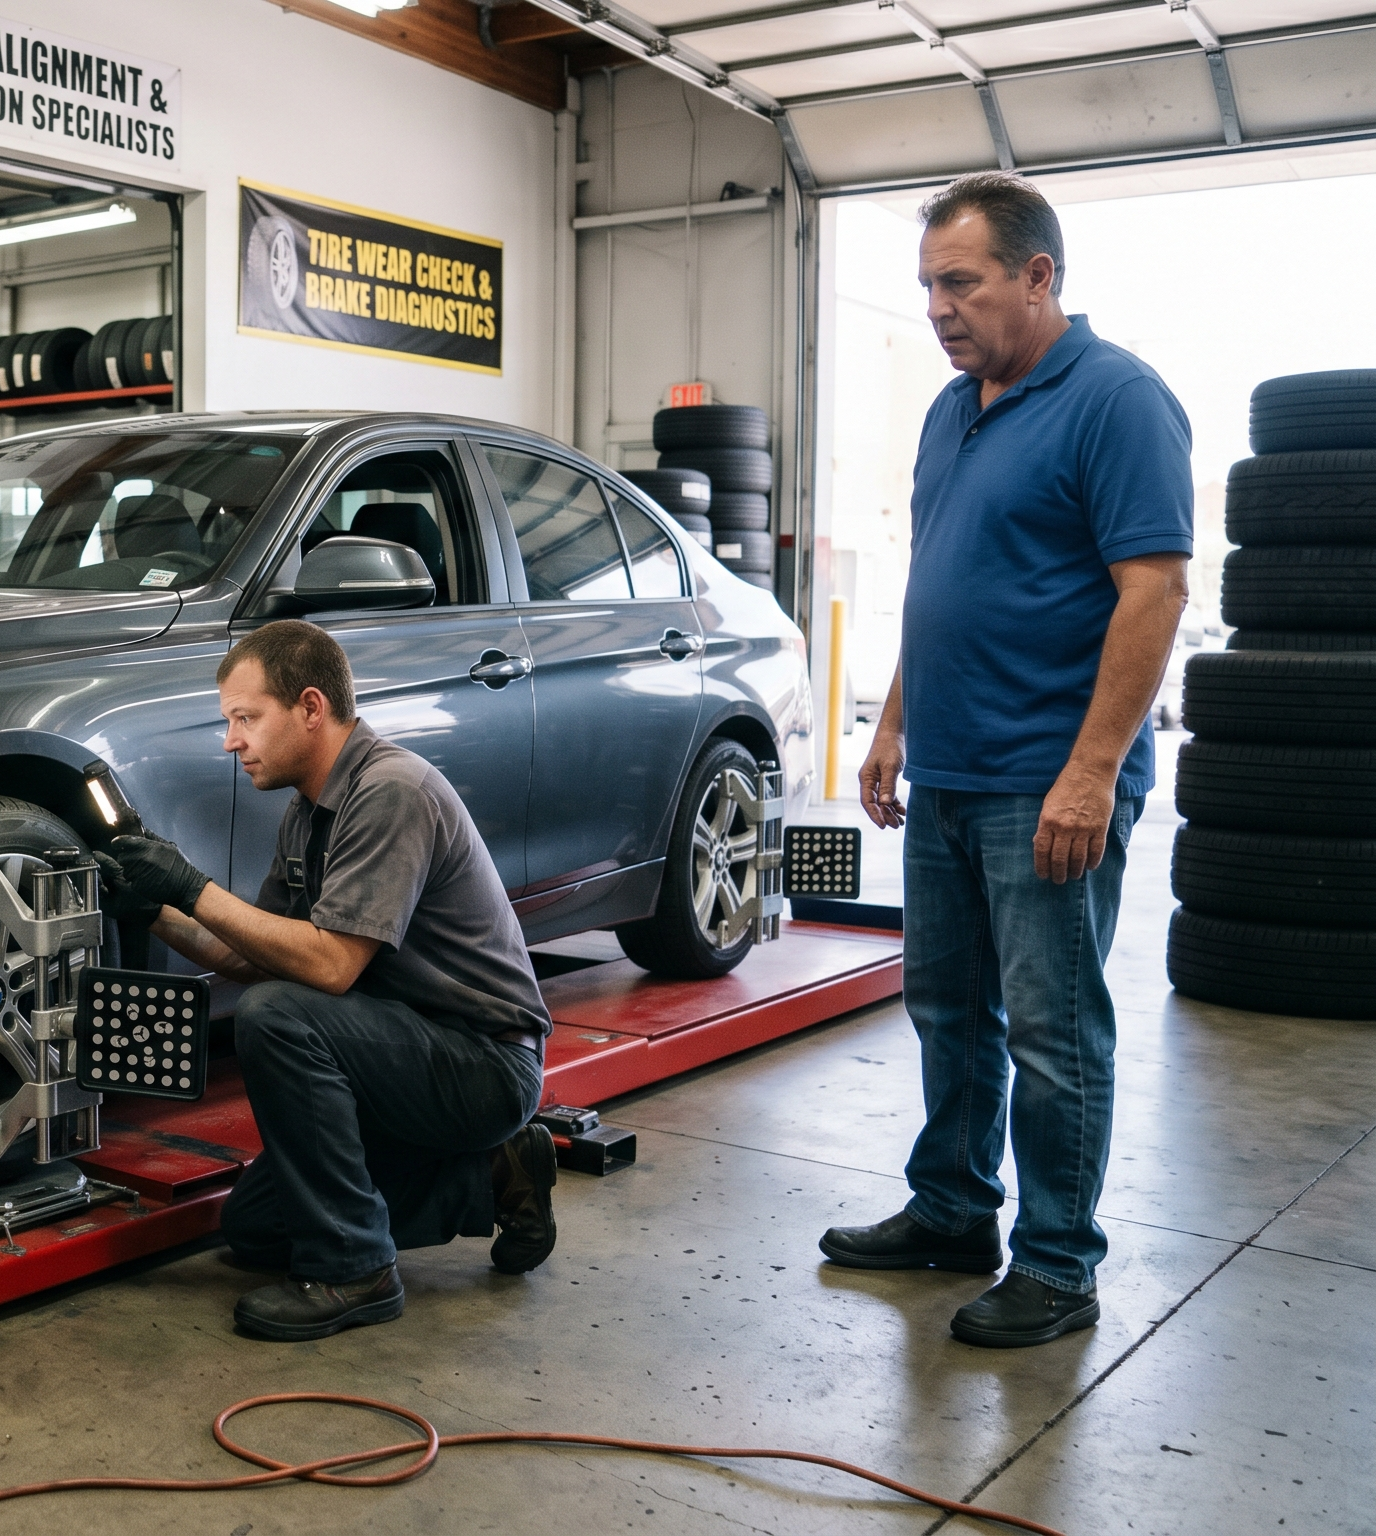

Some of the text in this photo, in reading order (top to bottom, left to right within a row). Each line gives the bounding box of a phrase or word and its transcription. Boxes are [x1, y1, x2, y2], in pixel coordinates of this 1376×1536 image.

[32, 94, 175, 160] SPECIALISTS
[150, 78, 168, 114] &
[307, 228, 493, 301] TIRE WEAR CHECK &
[305, 271, 496, 340] BRAKE DIAGNOSTICS
[670, 383, 704, 409] EXIT
